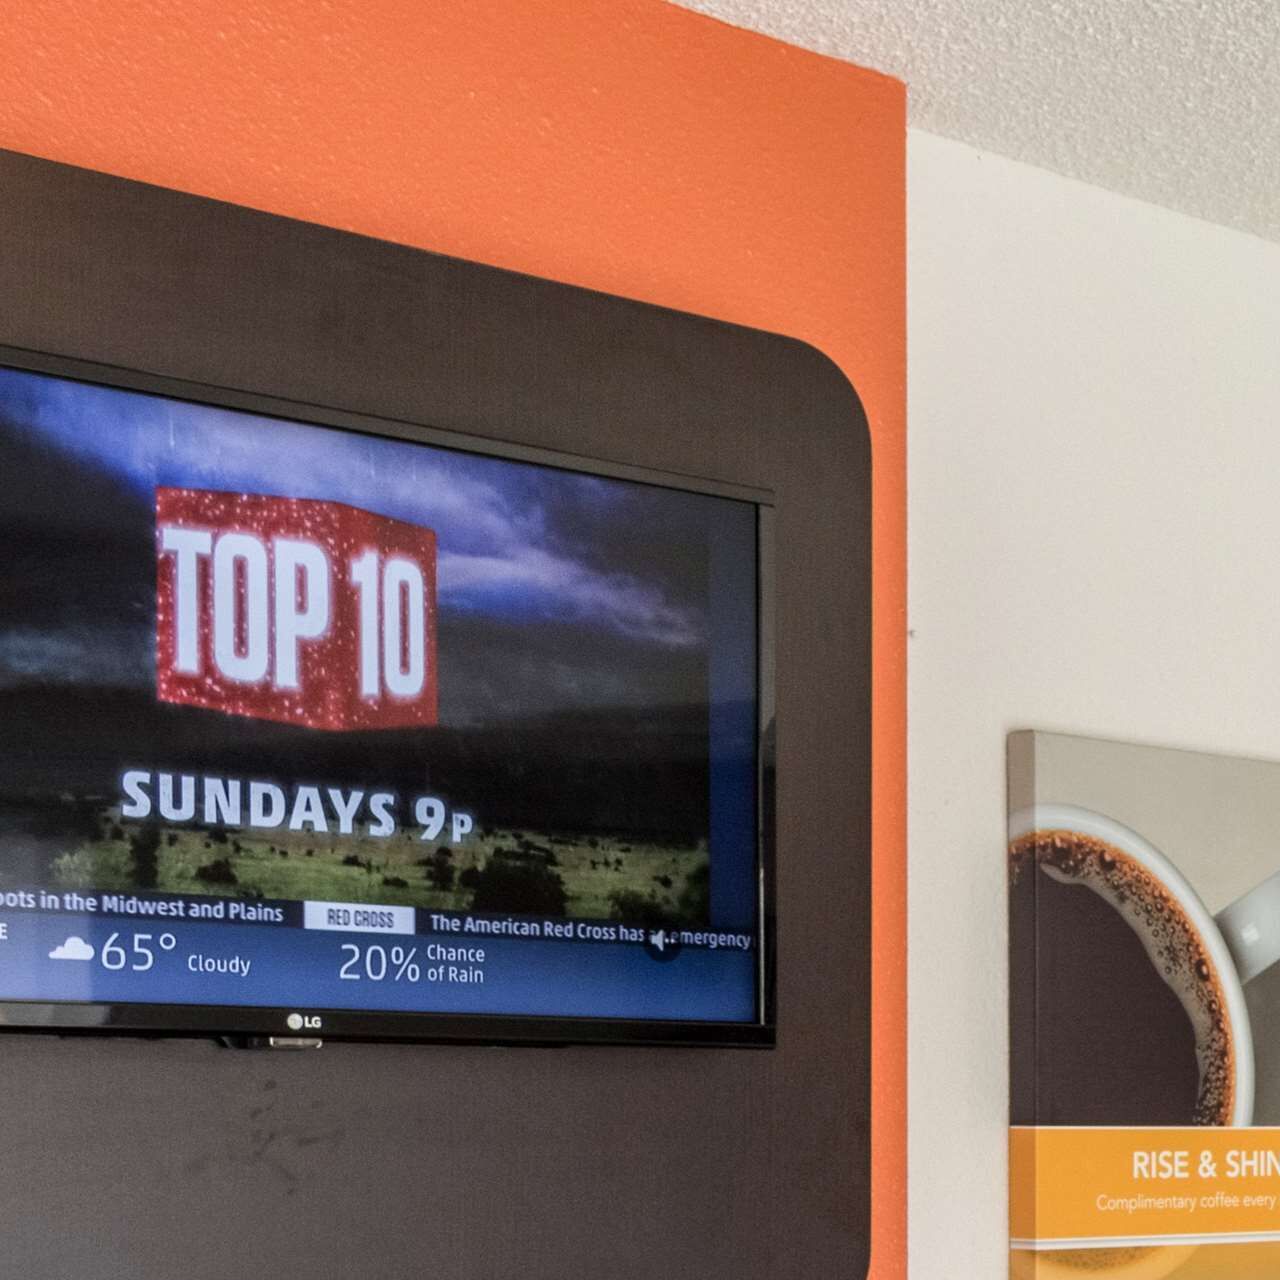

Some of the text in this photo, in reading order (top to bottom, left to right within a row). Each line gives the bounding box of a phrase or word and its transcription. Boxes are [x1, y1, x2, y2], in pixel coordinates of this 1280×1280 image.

[159, 526, 427, 699] TOP 10
[120, 769, 396, 839] SUNDAYS
[39, 890, 60, 910] in
[63, 892, 98, 912] the
[102, 894, 185, 918] Midwest
[188, 901, 225, 919] and
[228, 902, 285, 923] Plains
[326, 908, 395, 928] RED CROSS
[430, 914, 461, 932] The
[463, 916, 541, 937] American
[544, 921, 574, 938] Red
[577, 923, 617, 941] Cross
[618, 926, 644, 942] has
[101, 931, 251, 977] 65° Cloudy
[339, 943, 485, 983] 20% Chance
[427, 964, 485, 984] of Rain
[304, 1016, 322, 1029] LG
[1132, 1150, 1189, 1179] RISE
[1197, 1149, 1218, 1179] &
[1095, 1193, 1197, 1213] Complimentary
[1200, 1193, 1240, 1208] coffee
[1243, 1195, 1276, 1210] every
